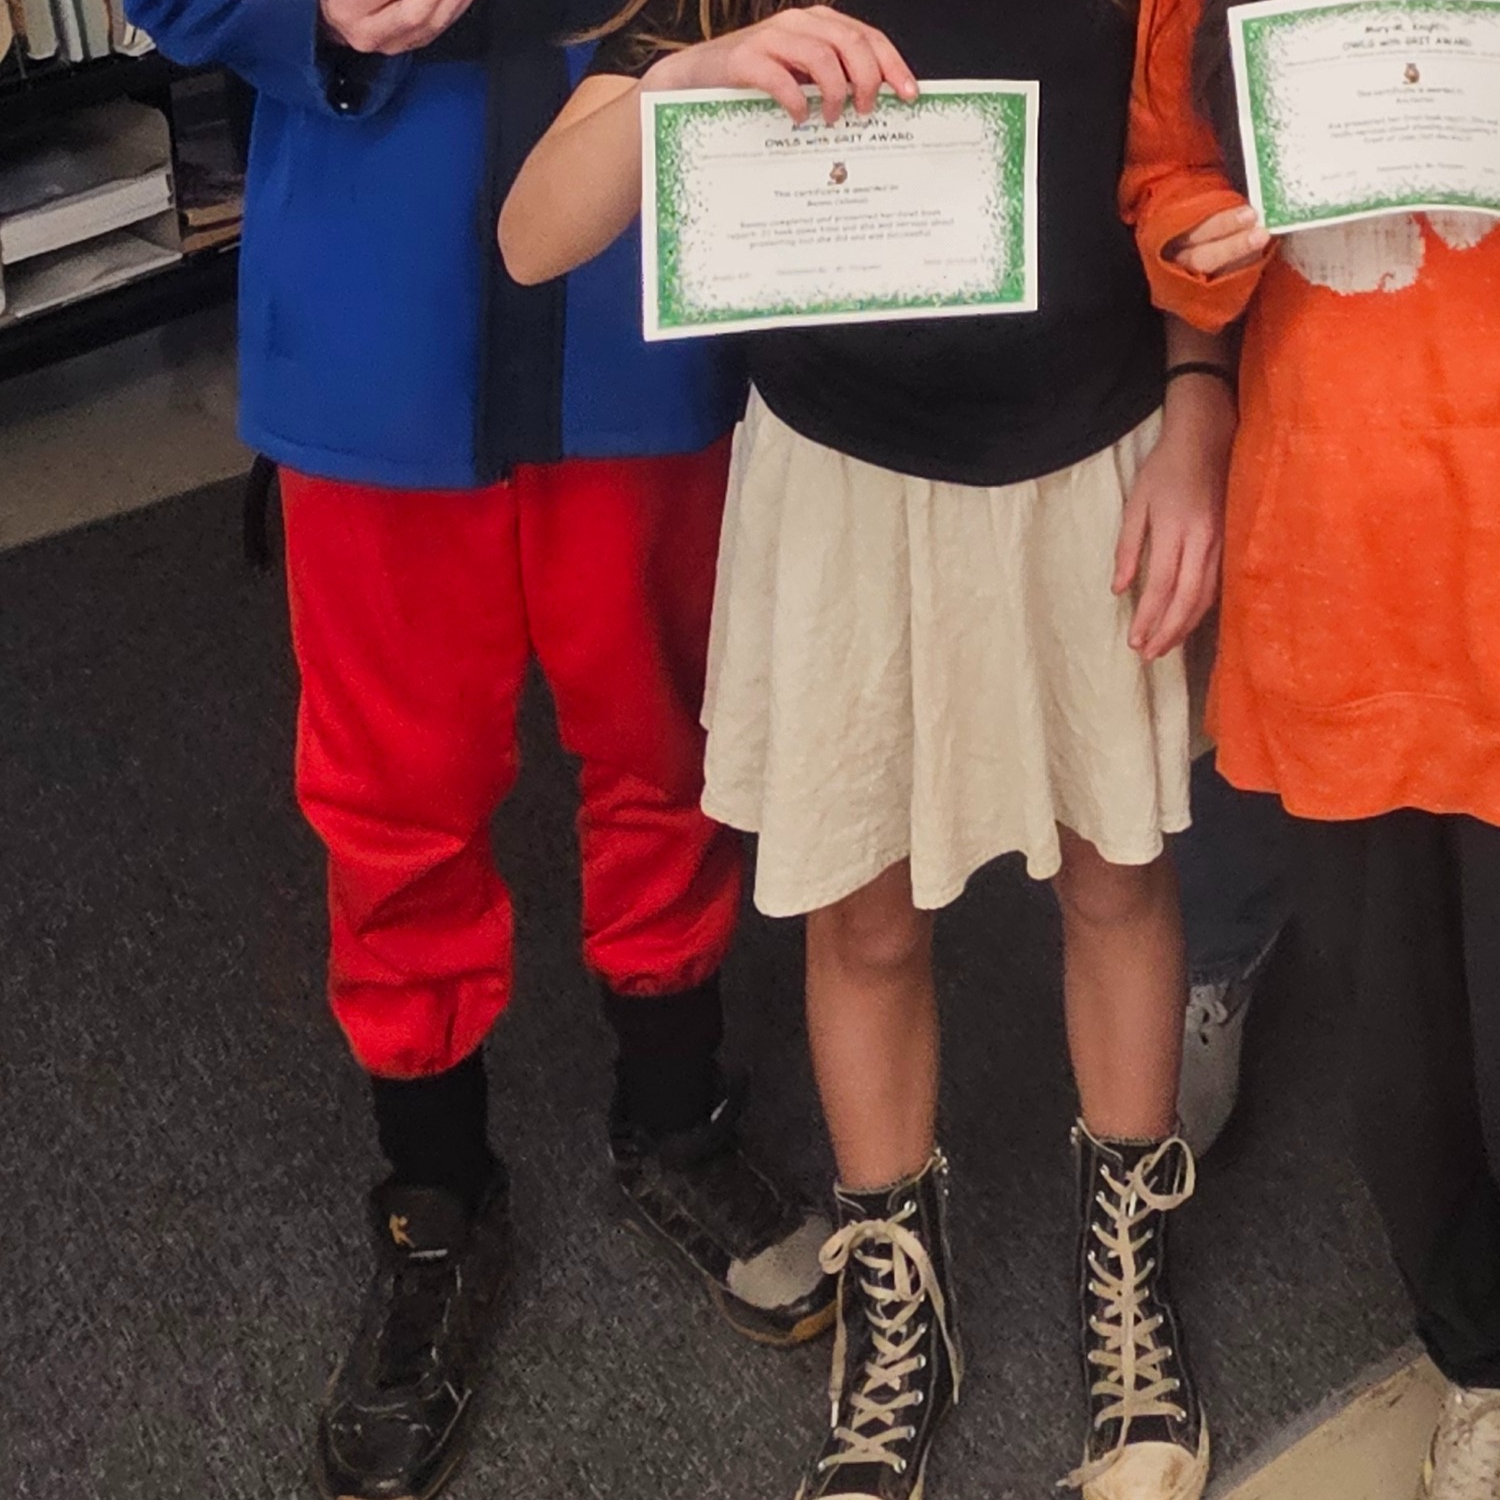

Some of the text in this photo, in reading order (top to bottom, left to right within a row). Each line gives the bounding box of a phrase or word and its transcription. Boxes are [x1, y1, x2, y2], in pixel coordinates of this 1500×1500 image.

[1406, 37, 1430, 45] GRIT
[764, 132, 914, 147] OWLS with GRIT AWARD
